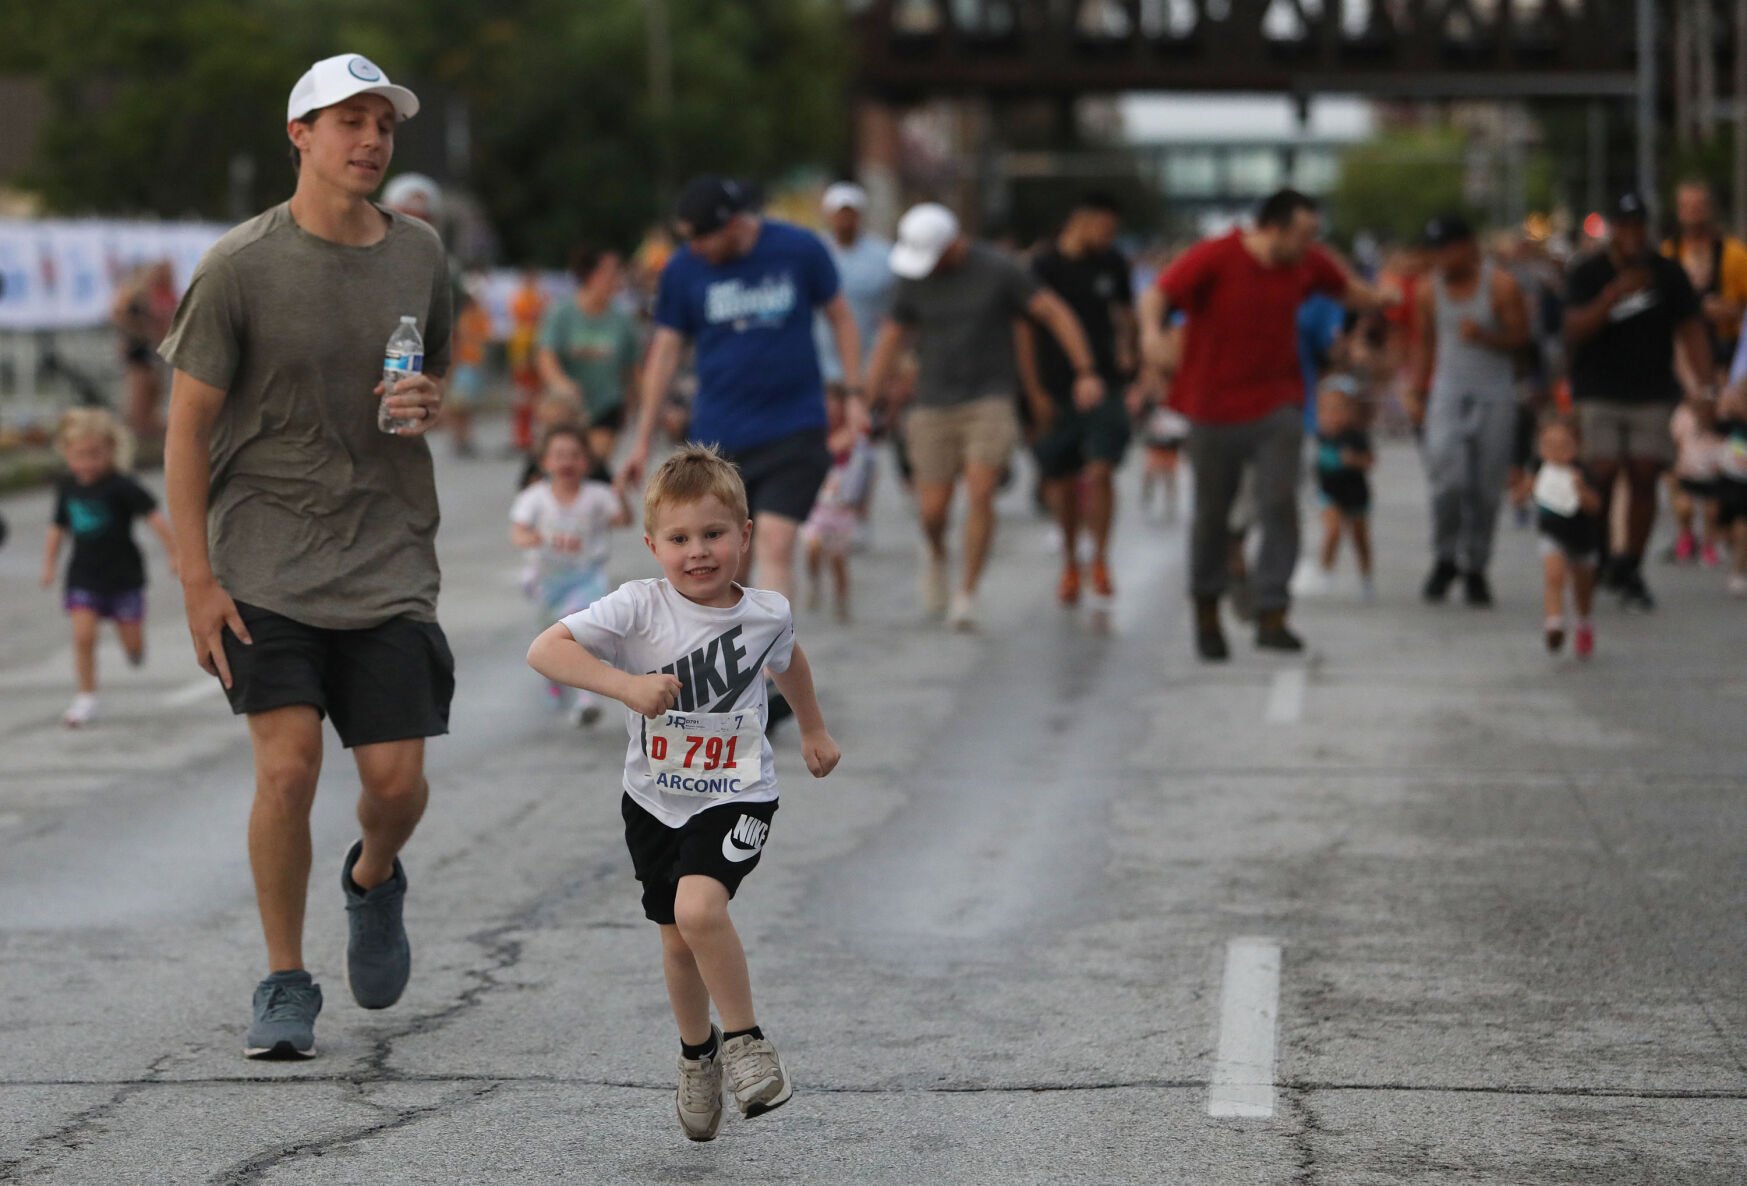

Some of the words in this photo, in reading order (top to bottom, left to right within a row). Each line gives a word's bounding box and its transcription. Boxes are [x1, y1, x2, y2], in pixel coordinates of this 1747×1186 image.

[734, 715, 744, 730] 7
[651, 735, 668, 761] D
[682, 735, 738, 771] 791
[656, 772, 741, 794] ARCONIC
[732, 813, 769, 850] NIKE
